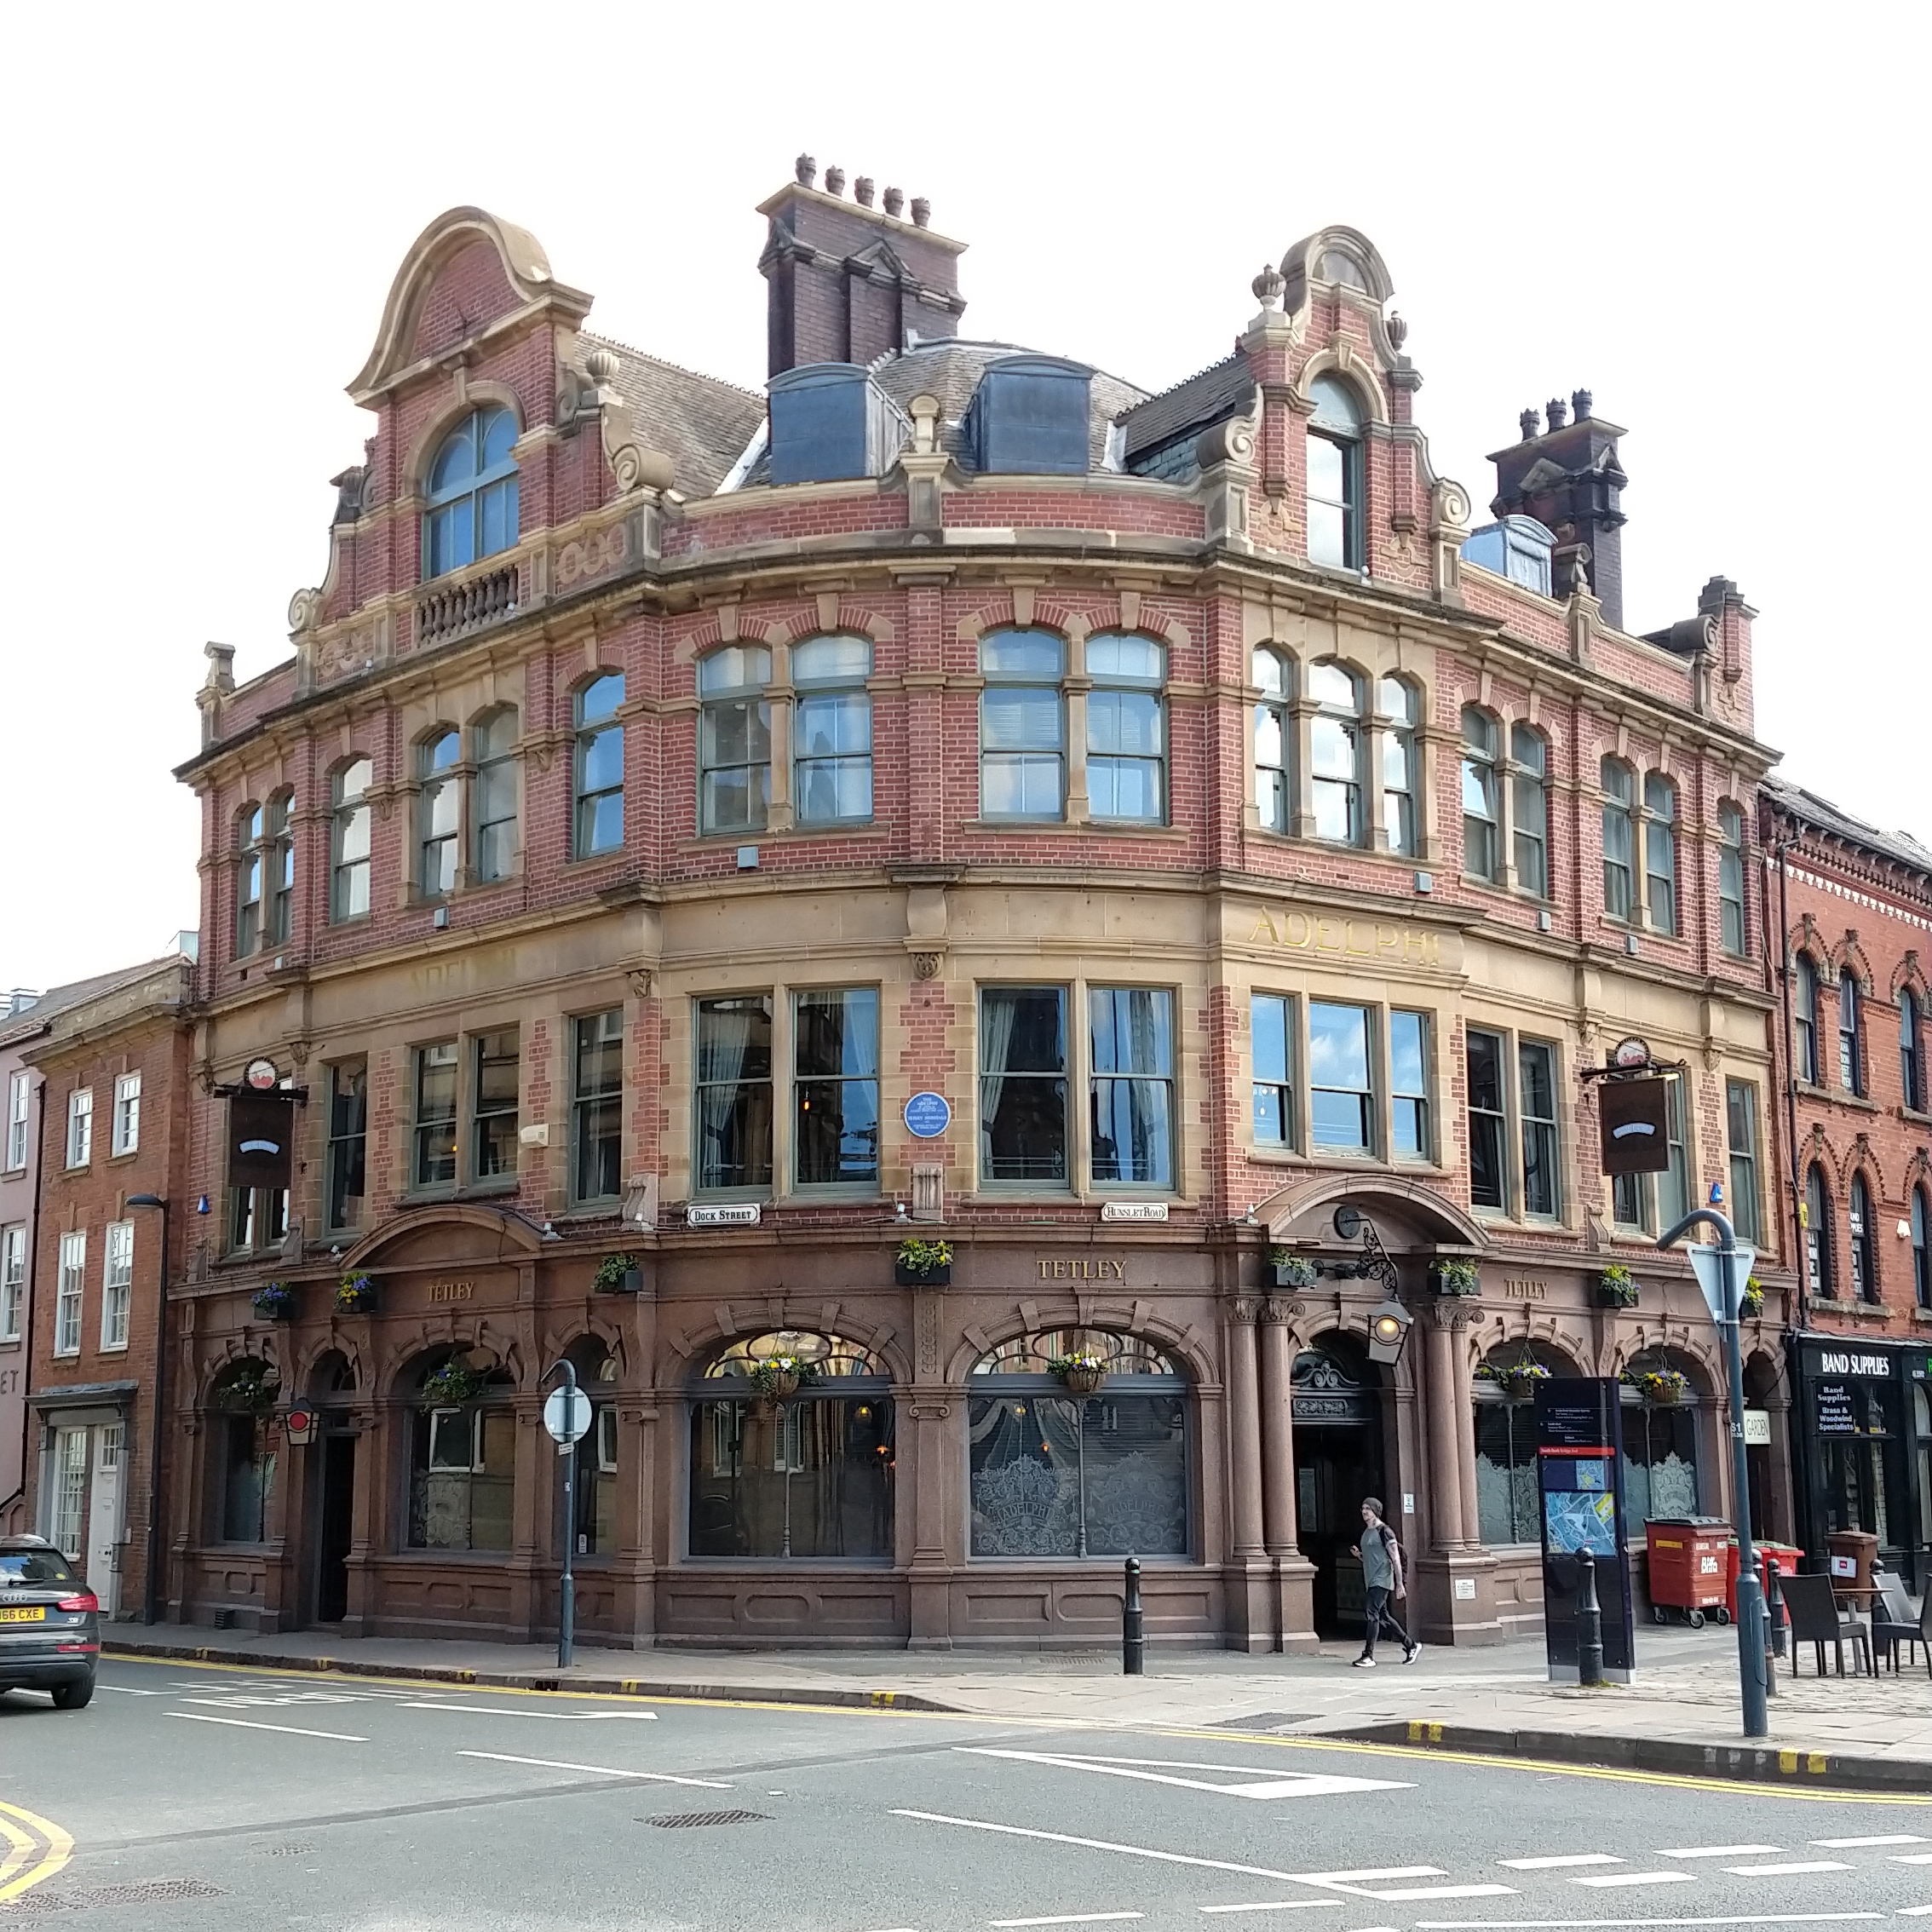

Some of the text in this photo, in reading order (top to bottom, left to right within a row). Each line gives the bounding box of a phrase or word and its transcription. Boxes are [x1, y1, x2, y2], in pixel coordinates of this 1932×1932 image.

[1249, 905, 1440, 967] ADELPHI
[694, 1210, 751, 1221] DOCK STREET
[1107, 1206, 1164, 1217] HUNSLET ROAD
[1037, 1260, 1127, 1279] TETLEY
[427, 1282, 474, 1302] TETLEY
[1505, 1279, 1549, 1299] TETLEY
[1821, 1353, 1849, 1373] BAND
[1850, 1354, 1889, 1376] SUPPLIES
[1817, 1394, 1851, 1403] Supplies
[1746, 1418, 1768, 1435] GARDEN
[1818, 1423, 1854, 1431] Specialists
[0, 1608, 40, 1619] 66 CXE
